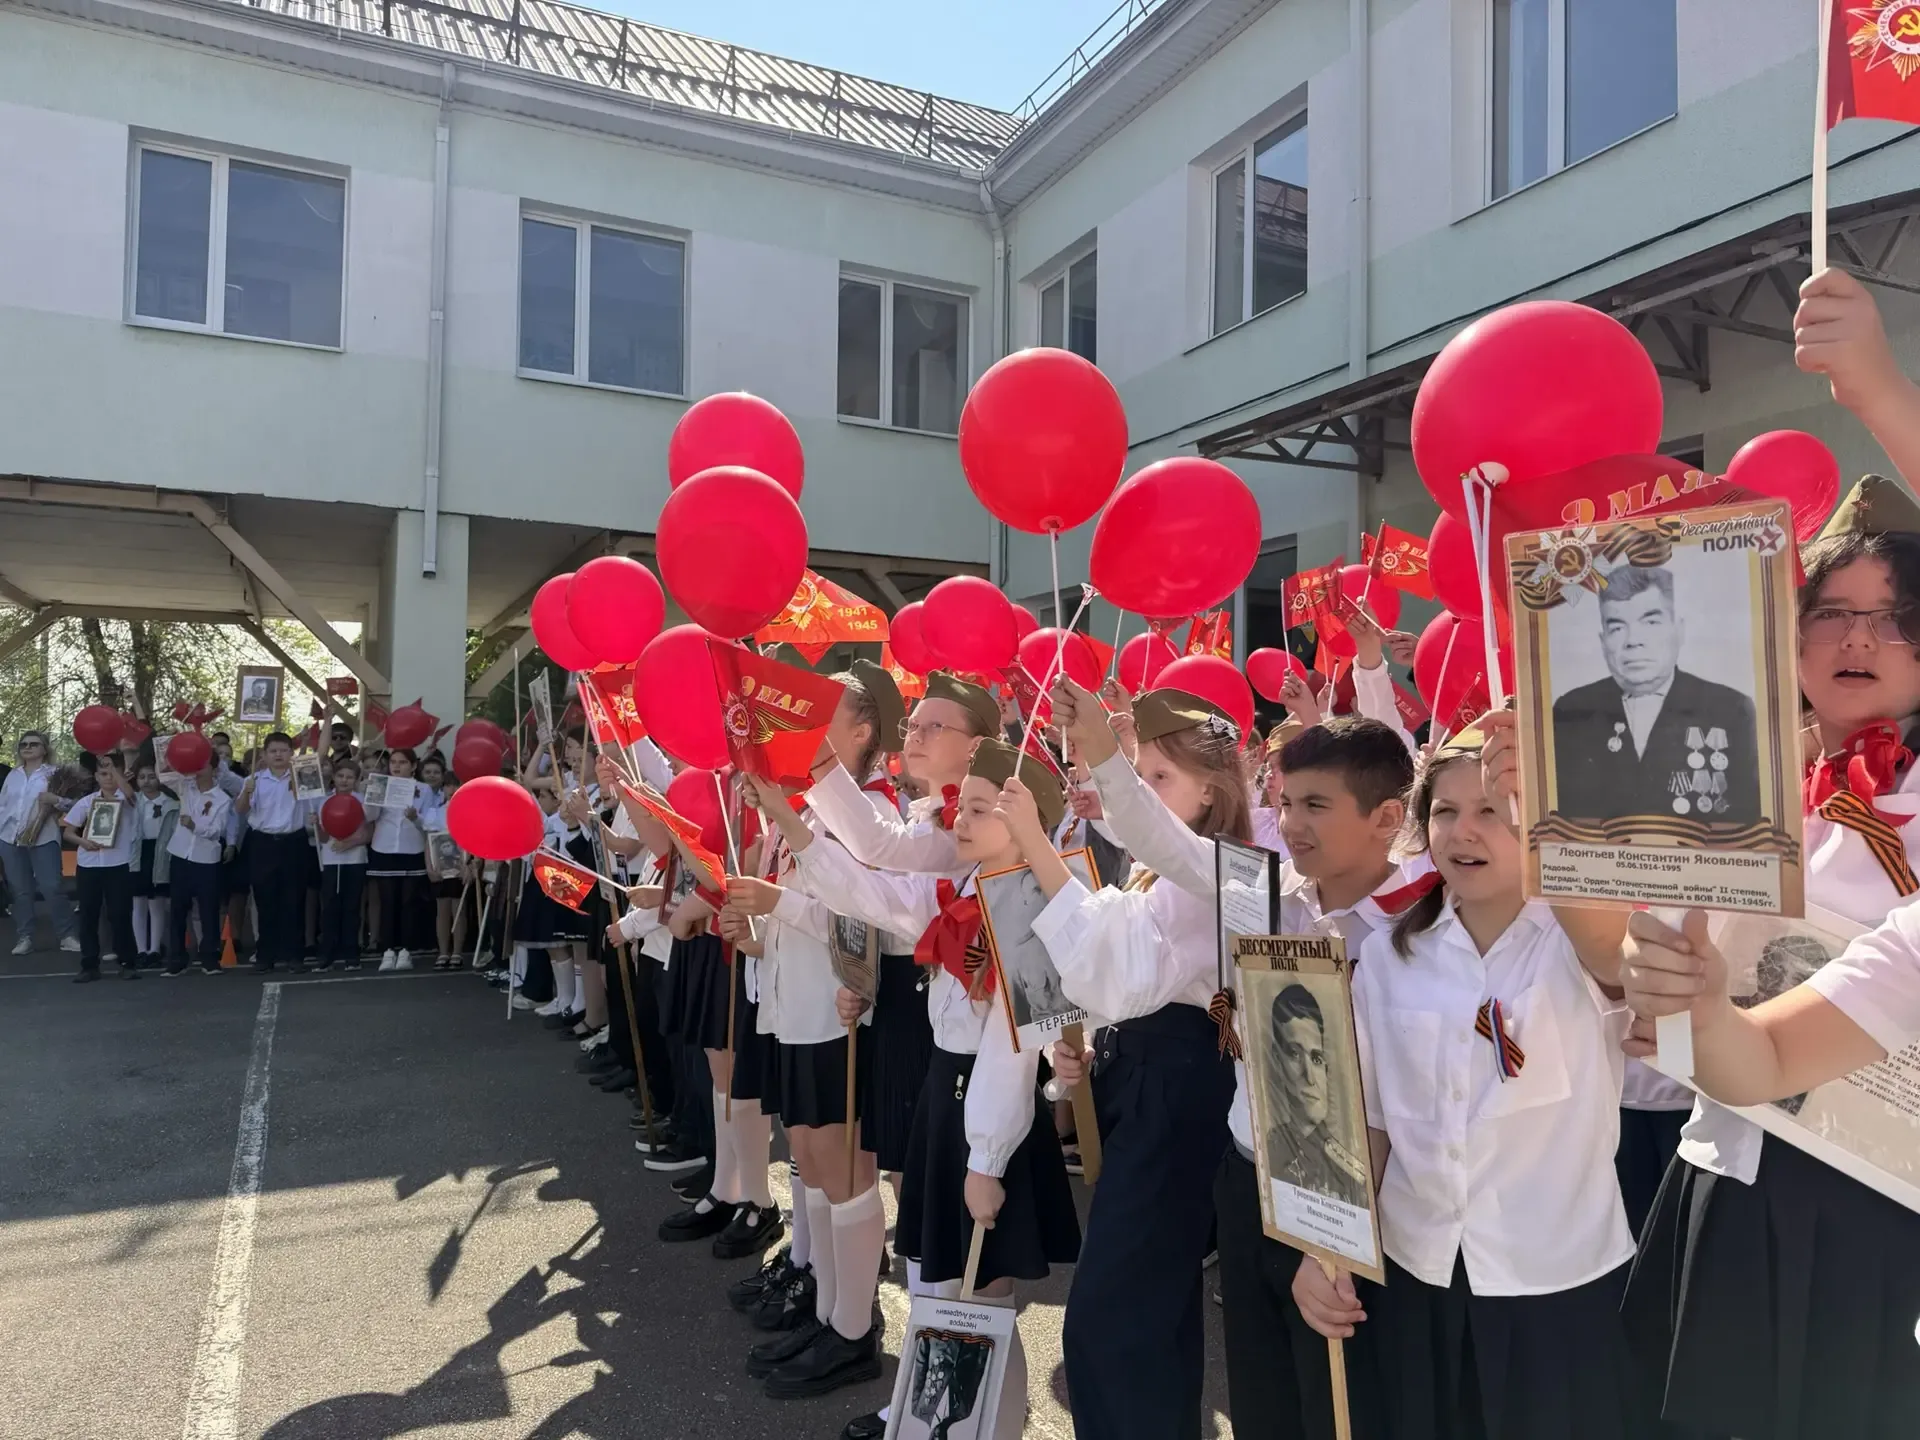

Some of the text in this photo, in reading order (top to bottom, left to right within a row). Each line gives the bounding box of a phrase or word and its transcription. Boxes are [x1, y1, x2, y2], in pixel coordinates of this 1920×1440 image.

[1561, 470, 1719, 528] 9 МАЯ
[1703, 534, 1756, 552] ПОЛК
[838, 607, 867, 617] 1941
[848, 620, 878, 630] 1945
[742, 675, 814, 717] 9 МАЯ
[1559, 847, 1768, 868] Леонтьев Константин Яковлевич
[1616, 861, 1682, 872] 05.06.1914-1995
[1542, 864, 1578, 872] Рядовой.
[1543, 874, 1581, 884] Награды:
[1584, 877, 1610, 886] Орден
[1731, 888, 1770, 898] степени,
[1590, 887, 1619, 896] победу
[1637, 890, 1684, 901] Германией
[1238, 936, 1333, 959] БЕССМЕРТНЫЙ
[1270, 957, 1299, 971] ПОЛК
[1036, 1009, 1088, 1032] ТЕРЕНИН
